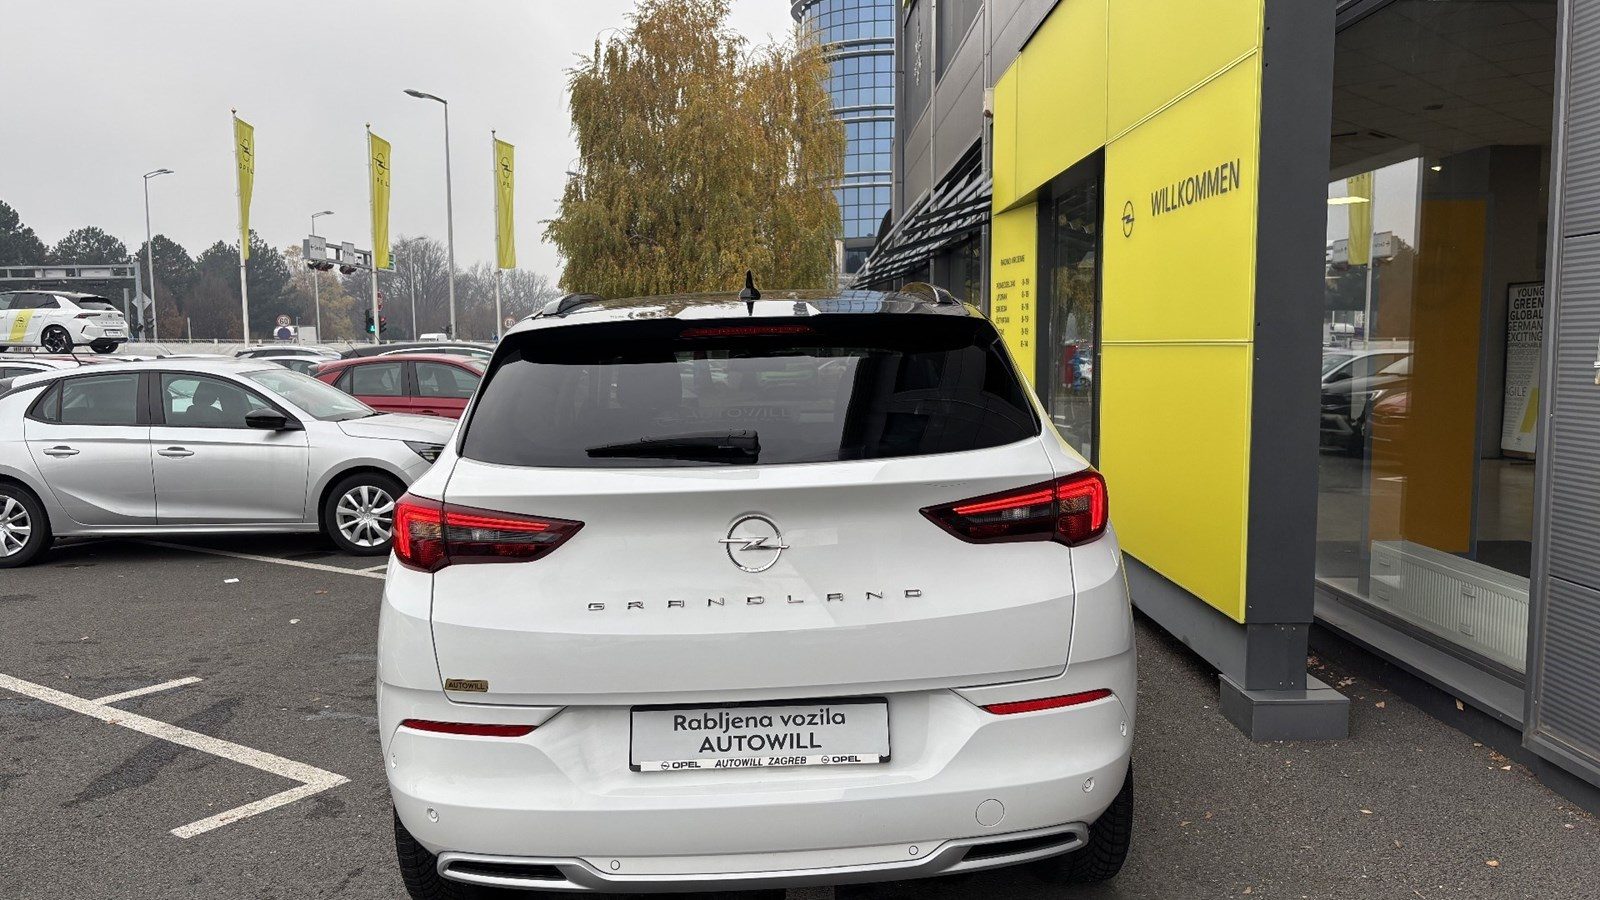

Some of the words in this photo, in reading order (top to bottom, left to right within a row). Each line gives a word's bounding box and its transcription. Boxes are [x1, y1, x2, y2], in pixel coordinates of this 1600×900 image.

[1150, 158, 1241, 217] WILLKOMMEN
[1517, 287, 1544, 298] YOUNG
[1513, 297, 1544, 309] GREEN
[1510, 309, 1543, 321] GLOBAL
[1508, 320, 1543, 332] GERMAN
[1507, 331, 1542, 342] EXCITING
[588, 588, 922, 611] GRANDLAND
[448, 681, 486, 690] AUTOWILL
[673, 712, 773, 734] Rabljena
[780, 708, 846, 727] vozila
[698, 732, 822, 753] AUTOWILL
[672, 761, 701, 769] OPEL
[715, 757, 764, 768] AUTOWILL
[768, 756, 807, 766] ZAGREB
[832, 755, 861, 763] OPEL
